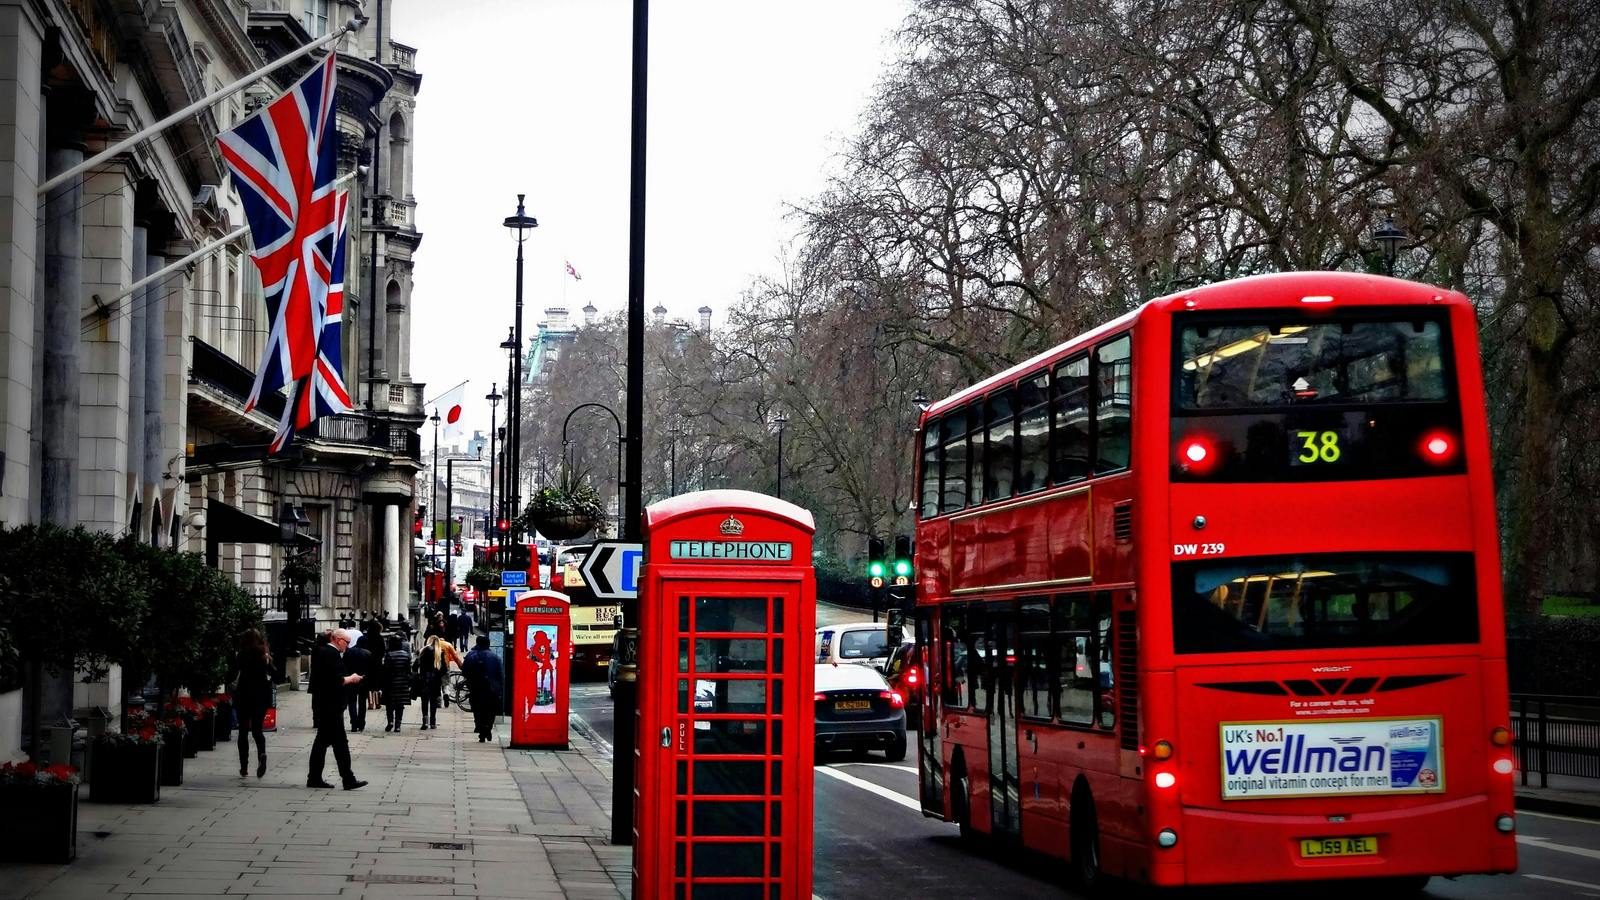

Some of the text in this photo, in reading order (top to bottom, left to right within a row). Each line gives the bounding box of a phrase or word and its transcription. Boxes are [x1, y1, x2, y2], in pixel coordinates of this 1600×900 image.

[1296, 431, 1340, 463] 38
[673, 541, 788, 559] TELEPHONE
[1173, 543, 1225, 556] DW 239
[1225, 728, 1284, 743] UK's No.1
[1225, 734, 1386, 775] wellman
[1228, 773, 1388, 793] original vitamin concept for men
[1306, 840, 1372, 855] LJ59 AEL
